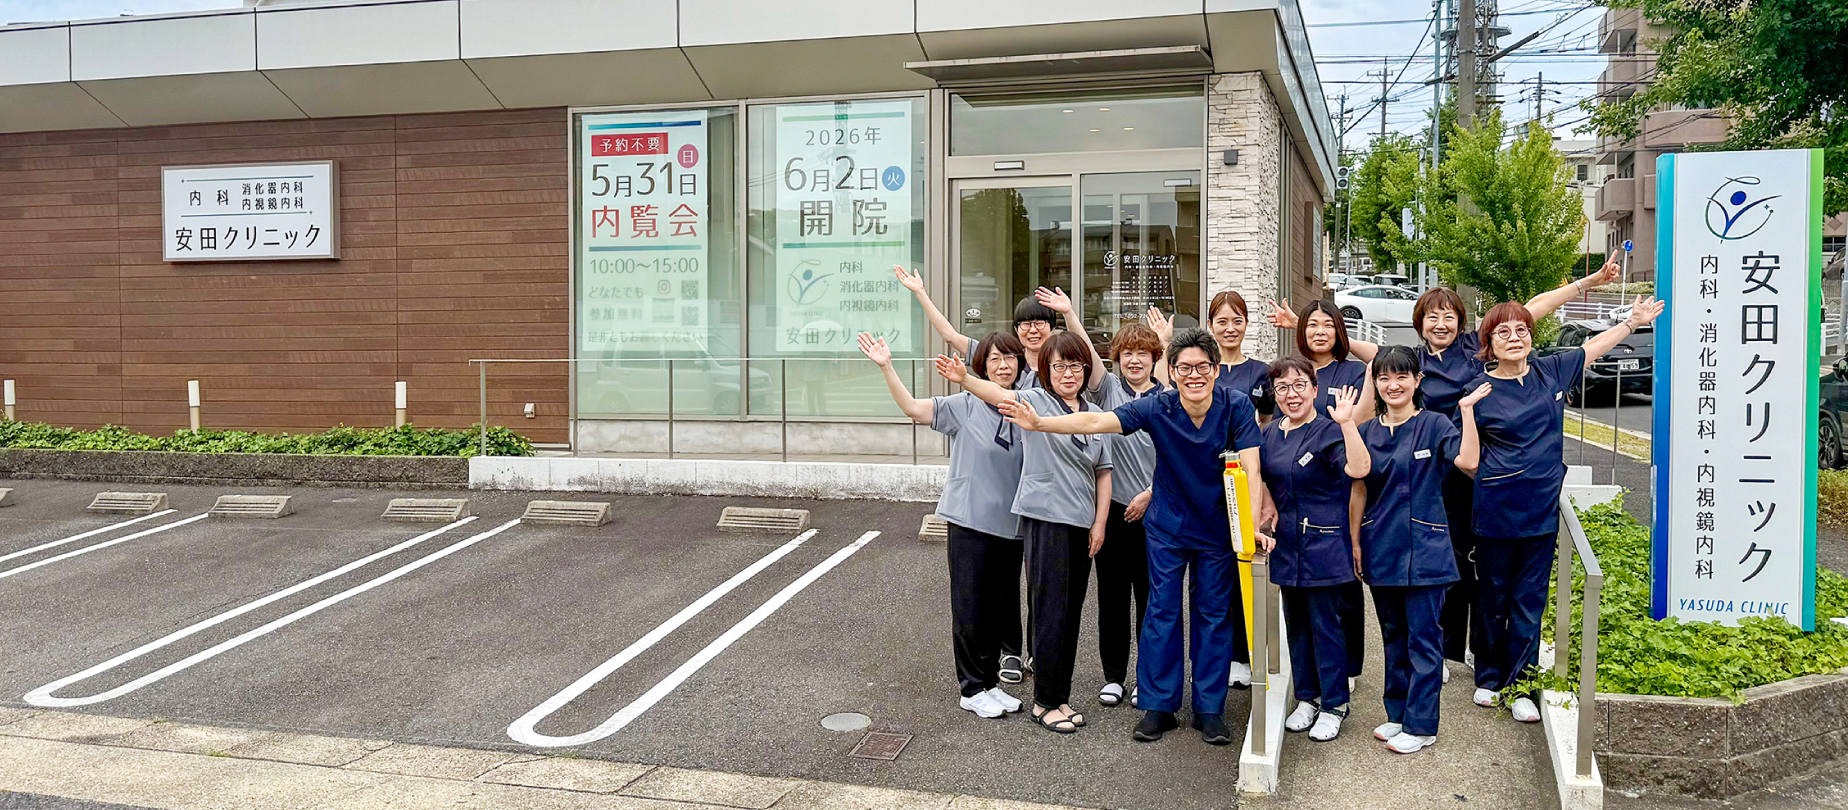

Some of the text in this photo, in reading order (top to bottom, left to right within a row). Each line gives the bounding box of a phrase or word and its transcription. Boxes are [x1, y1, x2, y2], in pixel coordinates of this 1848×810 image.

[599, 136, 661, 153] 予約不要
[805, 126, 882, 146] 2026年
[682, 150, 694, 164] 日
[591, 162, 697, 198] 5月31日
[784, 155, 878, 192] 6月2日
[241, 181, 304, 196] 消化器内科
[189, 189, 229, 207] 内科
[241, 196, 304, 211] 内視鏡内科
[591, 203, 699, 239] 内覧会
[799, 197, 888, 237] 開院
[175, 224, 321, 252] 安田クリニック
[839, 260, 863, 274] 内科
[1123, 254, 1176, 264] 安田クリニック
[588, 286, 645, 299] どなたでも
[839, 280, 899, 293] 消化器内科
[839, 299, 899, 312] 内視鏡内科
[1695, 254, 1719, 580] 内科・消化器内科・内視鏡内科
[1738, 250, 1781, 583] 安田クリニック
[1679, 598, 1789, 616] YASUDA CLINIC
